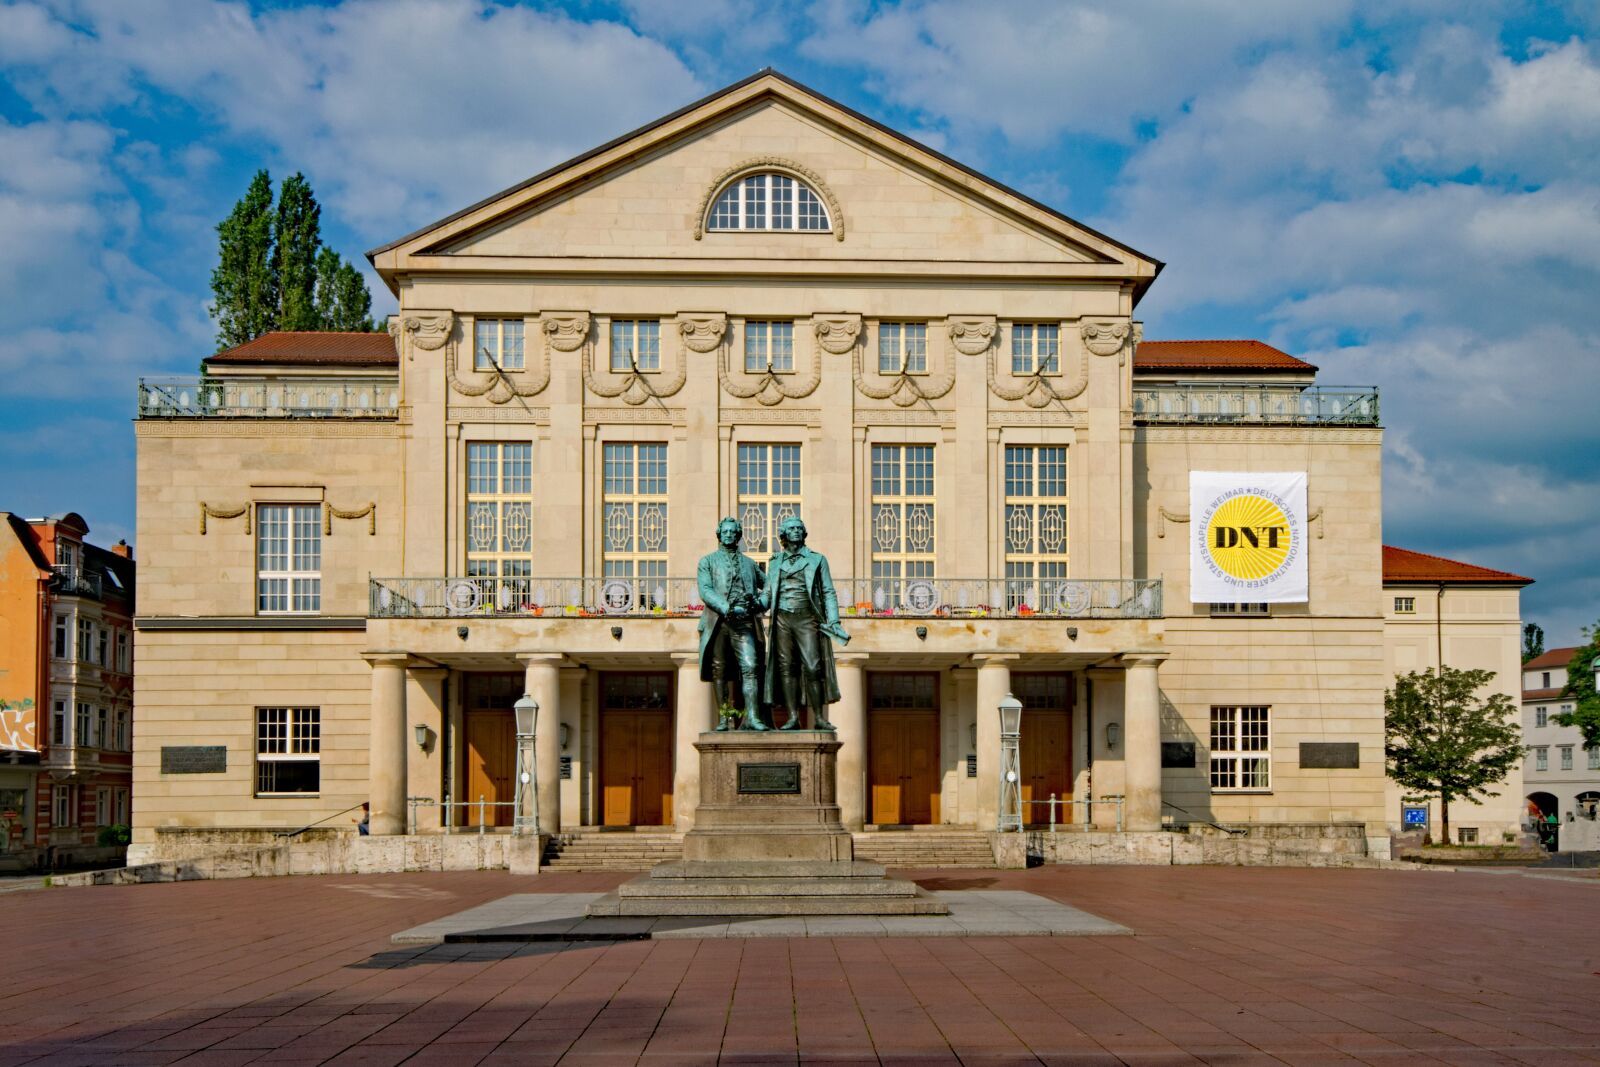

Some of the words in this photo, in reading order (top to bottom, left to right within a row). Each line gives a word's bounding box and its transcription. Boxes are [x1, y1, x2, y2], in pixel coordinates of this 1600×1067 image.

[1210, 487, 1244, 510] WEIMAR
[1253, 487, 1297, 527] DEUTSCHES
[1198, 508, 1224, 579] STAATSKAPELLE
[1213, 526, 1285, 549] DNT
[1246, 528, 1299, 589] NATIONALTHEATER
[1224, 576, 1244, 588] UND
